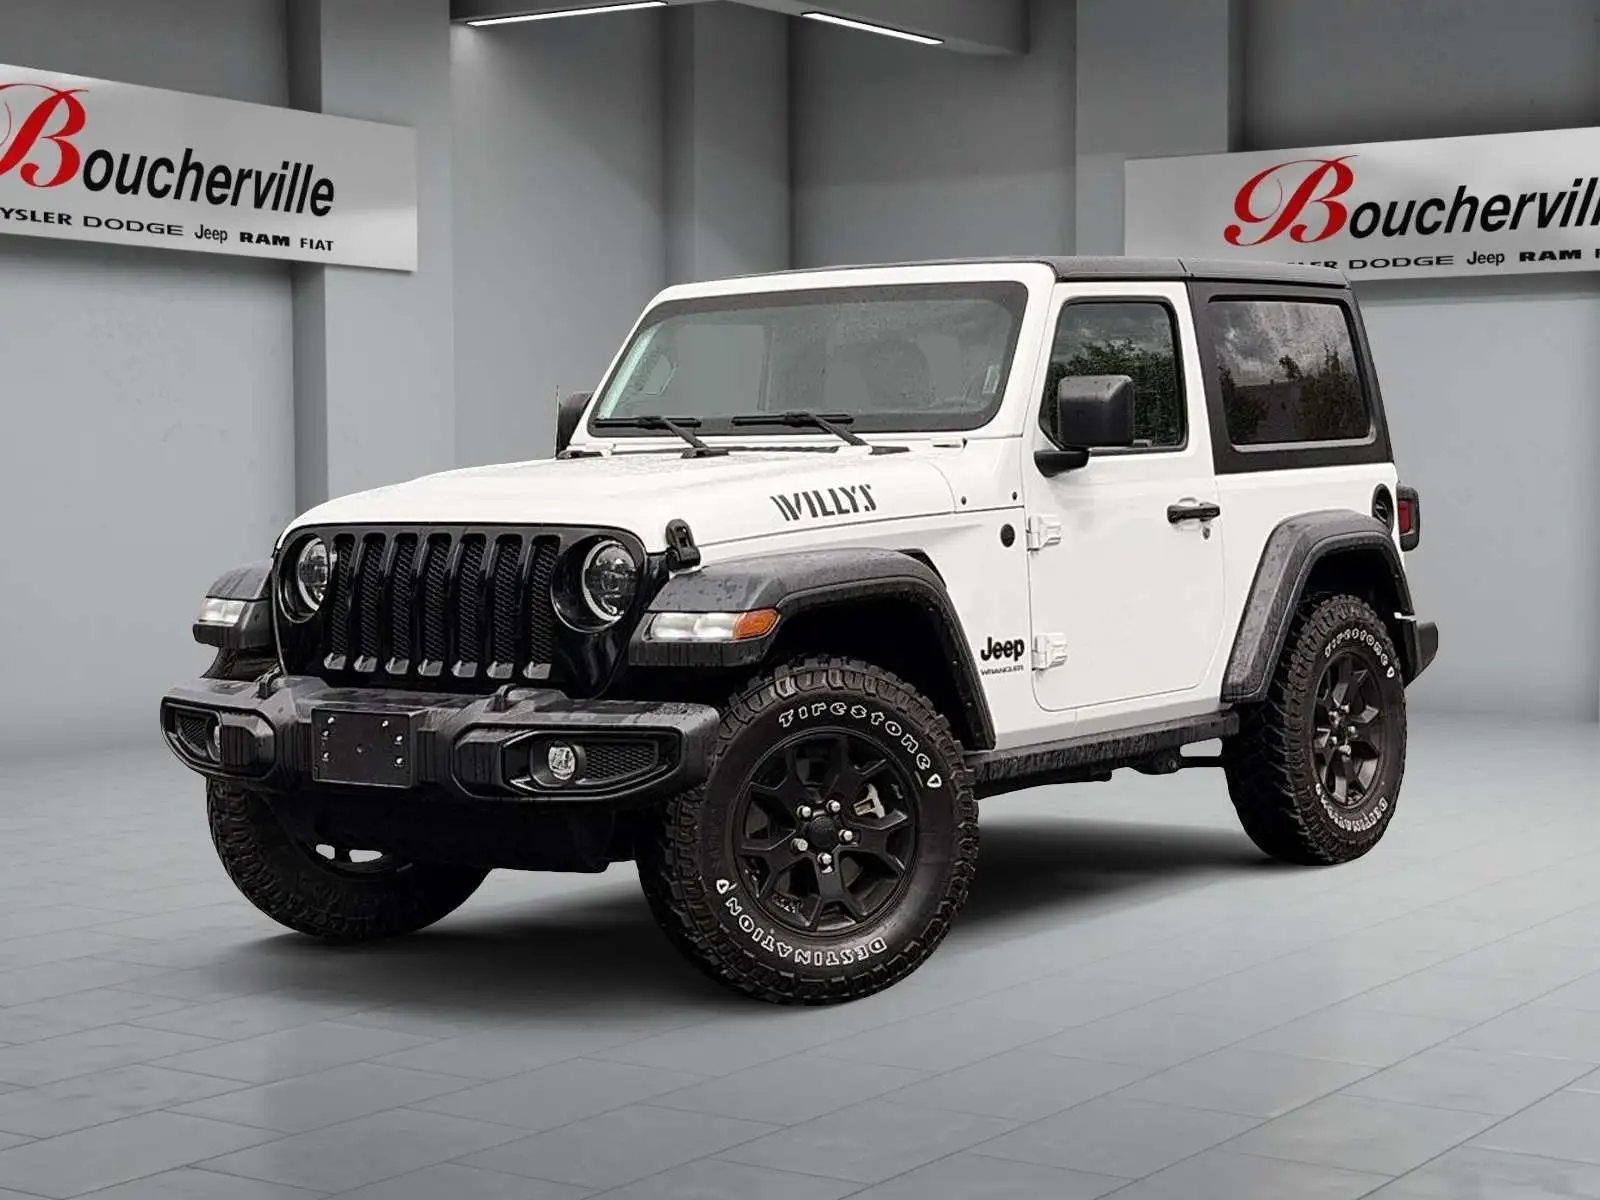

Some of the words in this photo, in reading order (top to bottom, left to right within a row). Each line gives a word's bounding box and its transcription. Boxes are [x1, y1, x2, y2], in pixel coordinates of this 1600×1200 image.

[0, 83, 334, 217] Boucherville
[83, 215, 184, 236] DODGE
[195, 223, 228, 244] Jeep
[239, 231, 290, 247] RAM
[300, 237, 334, 252] FIAT
[1348, 254, 1455, 270] DODGE
[1466, 250, 1506, 267] Jeep
[1519, 249, 1582, 263] RAM
[769, 484, 876, 521] WILLYS
[980, 636, 1025, 662] Jeep
[980, 664, 1024, 676] WRANGLER
[725, 897, 887, 966] DESTINATION
